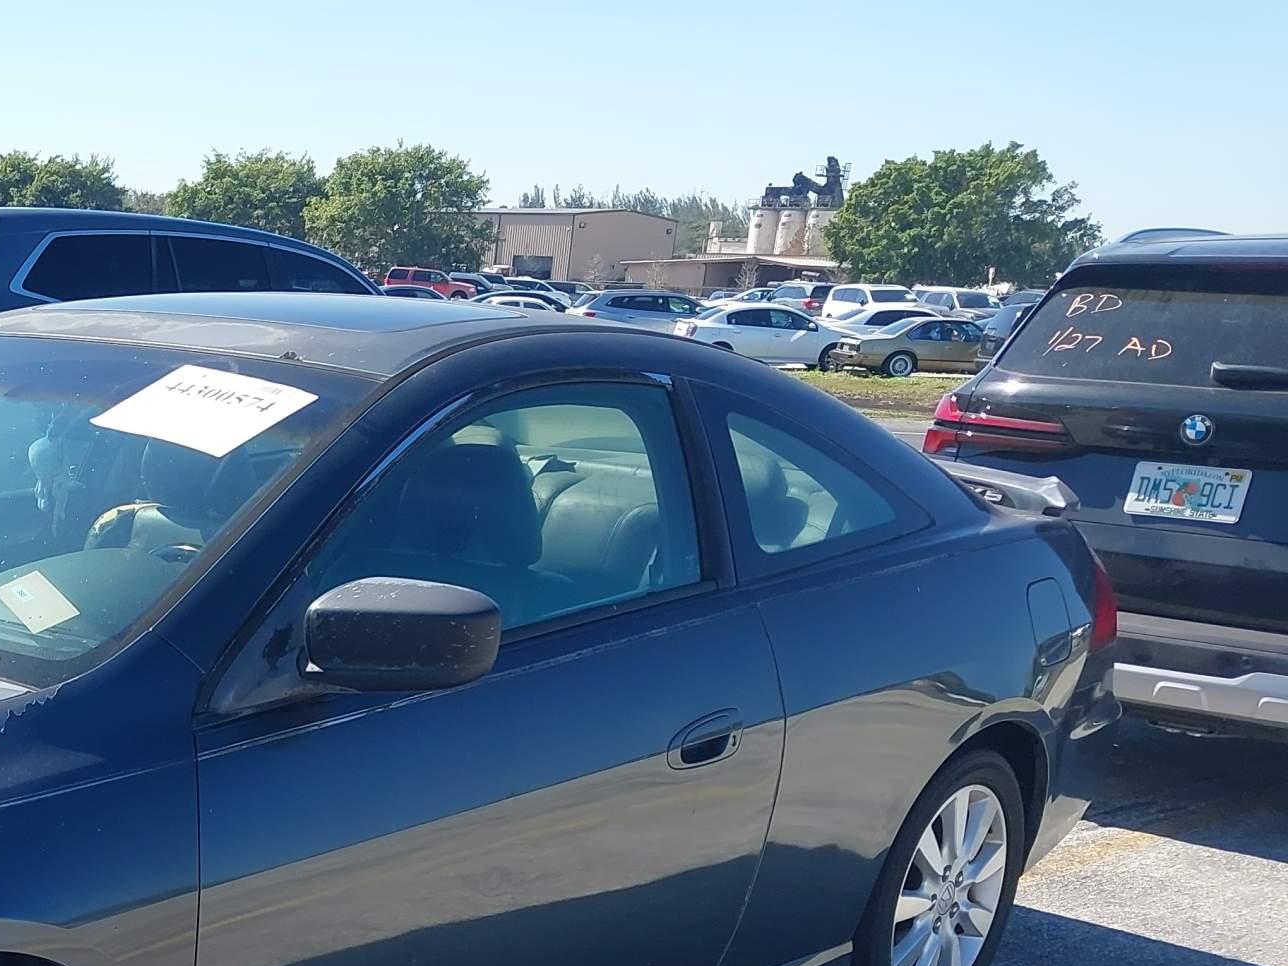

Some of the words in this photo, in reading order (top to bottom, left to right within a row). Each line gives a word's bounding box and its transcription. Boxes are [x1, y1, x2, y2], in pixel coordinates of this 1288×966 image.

[1065, 293, 1123, 318] BD
[1042, 326, 1103, 356] 1/27
[1117, 336, 1172, 360] AD
[165, 381, 277, 413] 44300574
[1150, 505, 1187, 515] SUNSHINE
